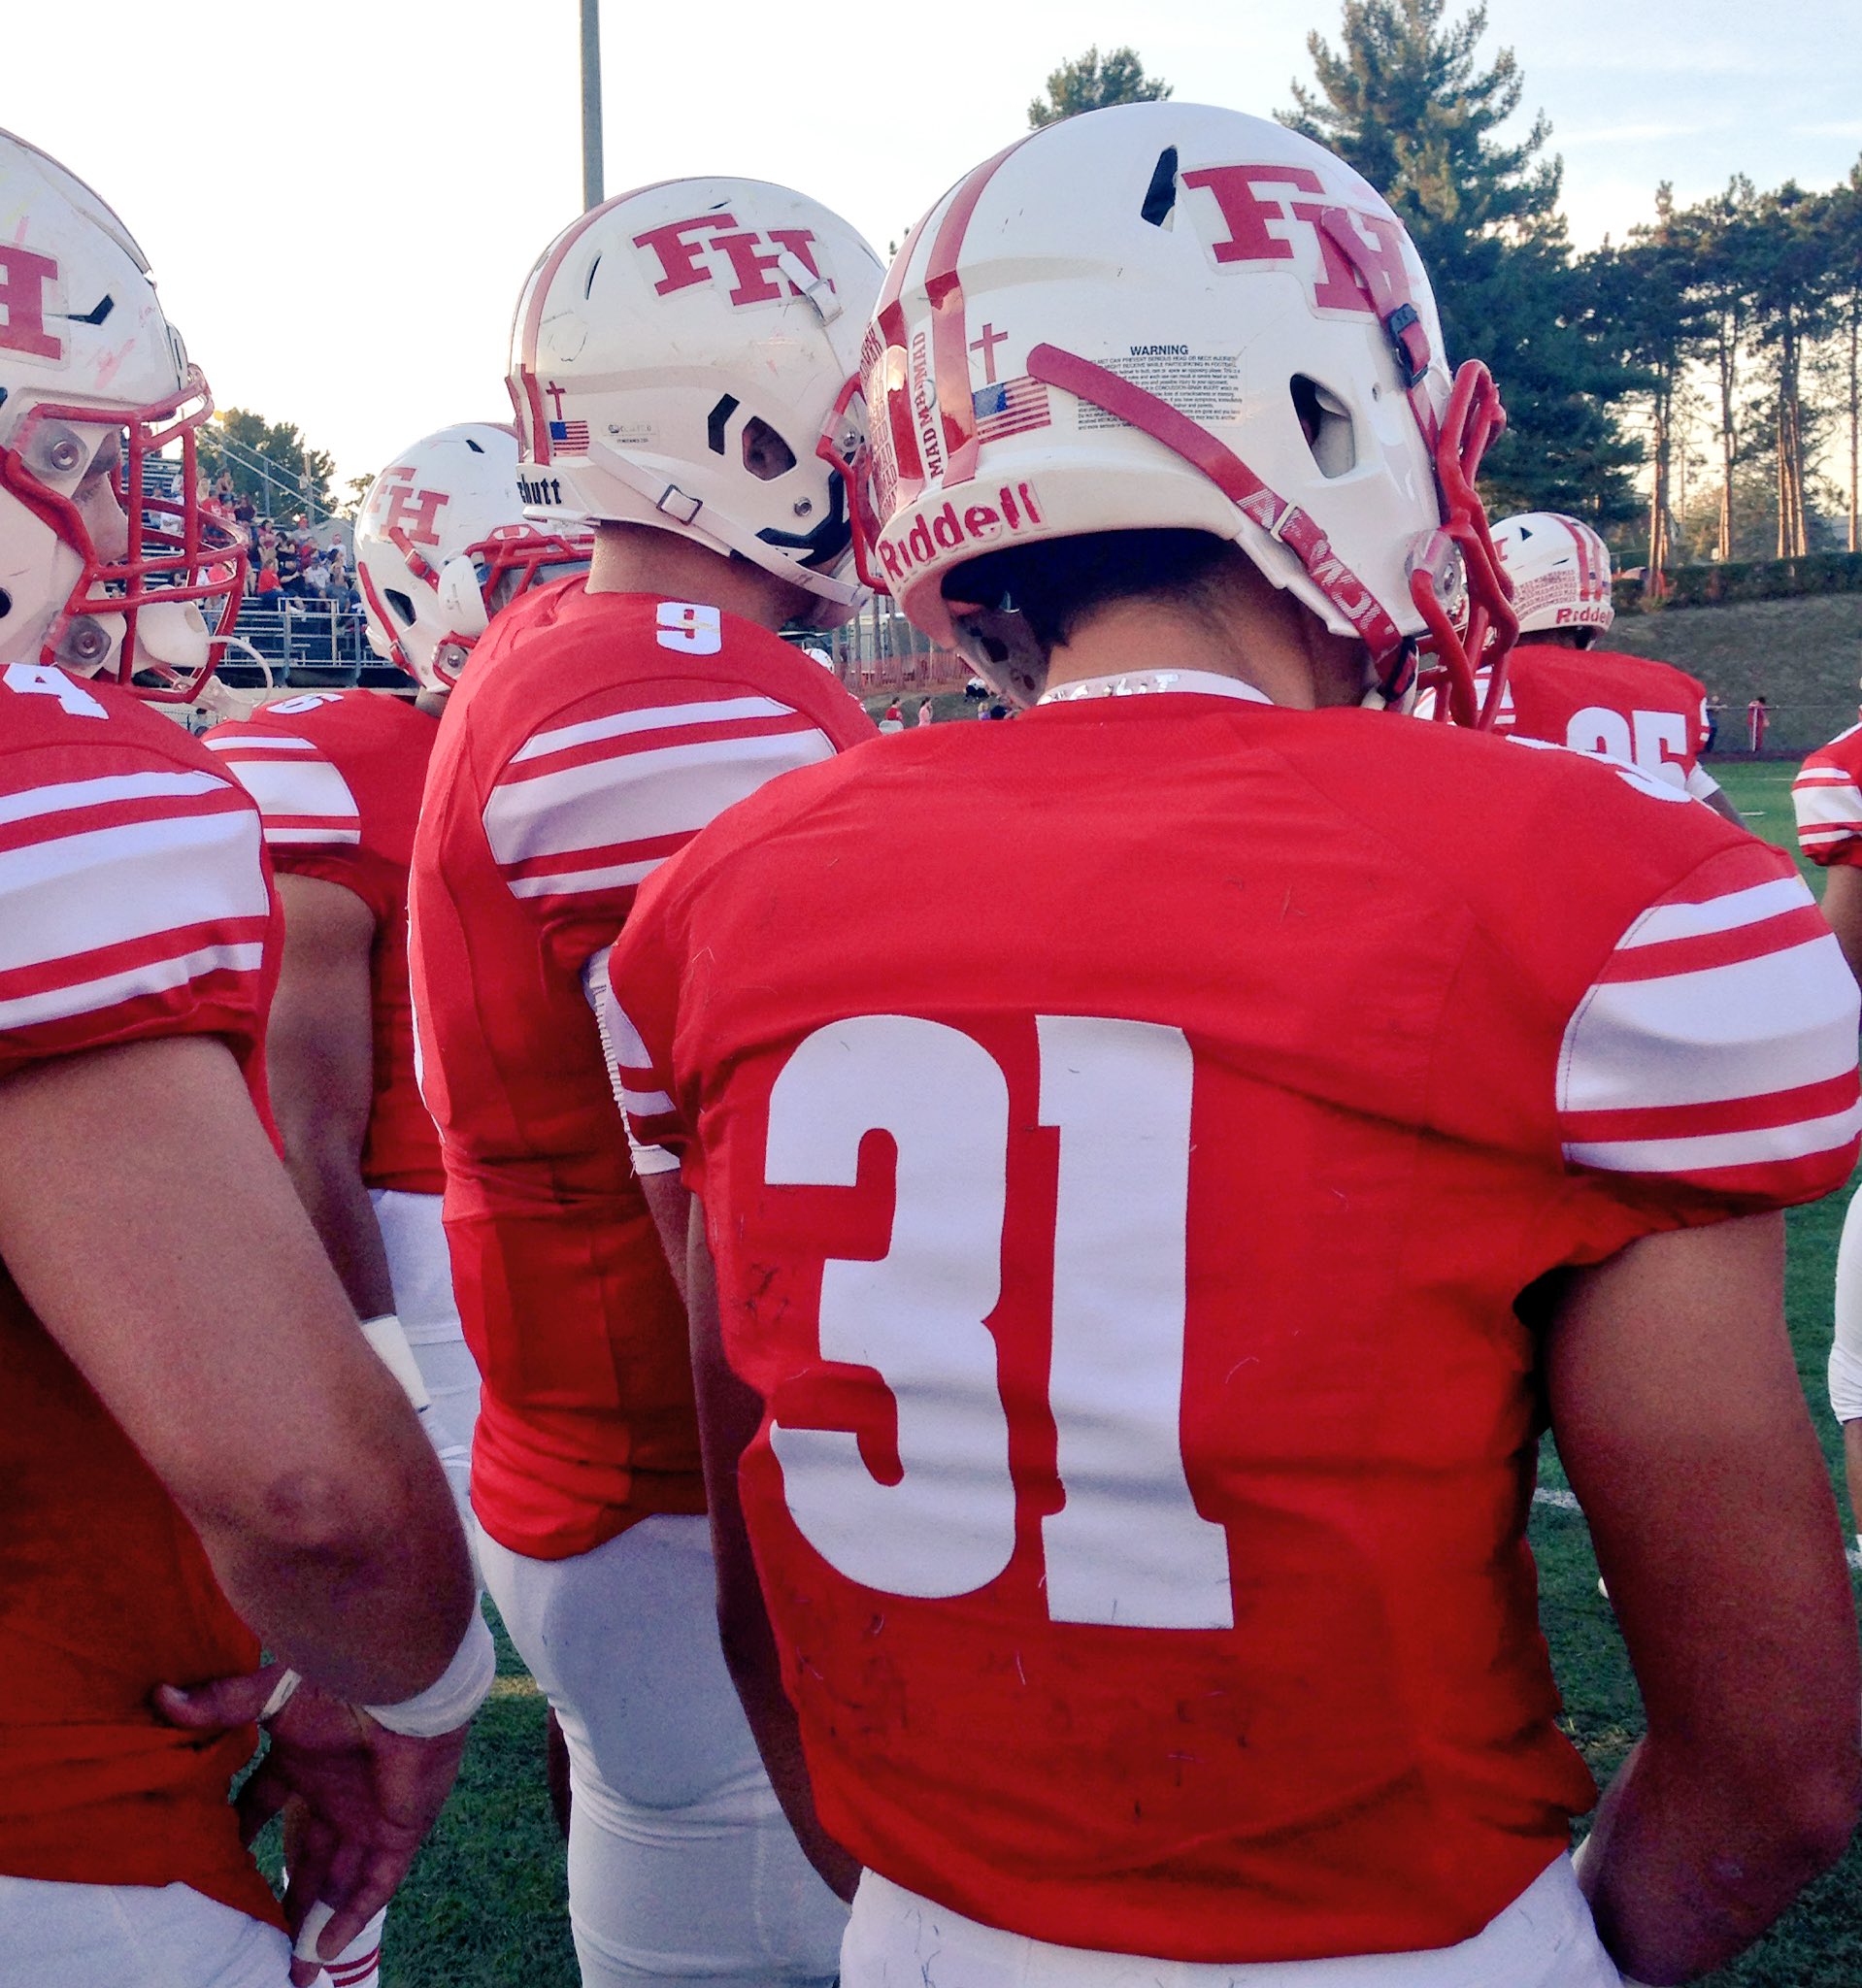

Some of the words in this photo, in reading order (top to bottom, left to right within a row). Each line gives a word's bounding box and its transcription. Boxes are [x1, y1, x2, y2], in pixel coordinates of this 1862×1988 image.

[913, 332, 928, 381] MAD
[1130, 345, 1189, 356] WARNING
[922, 428, 944, 480] MAD
[880, 482, 1041, 580] Riddell
[656, 602, 721, 655] 9
[3, 662, 110, 720] 4
[764, 1013, 1234, 1630] 31
